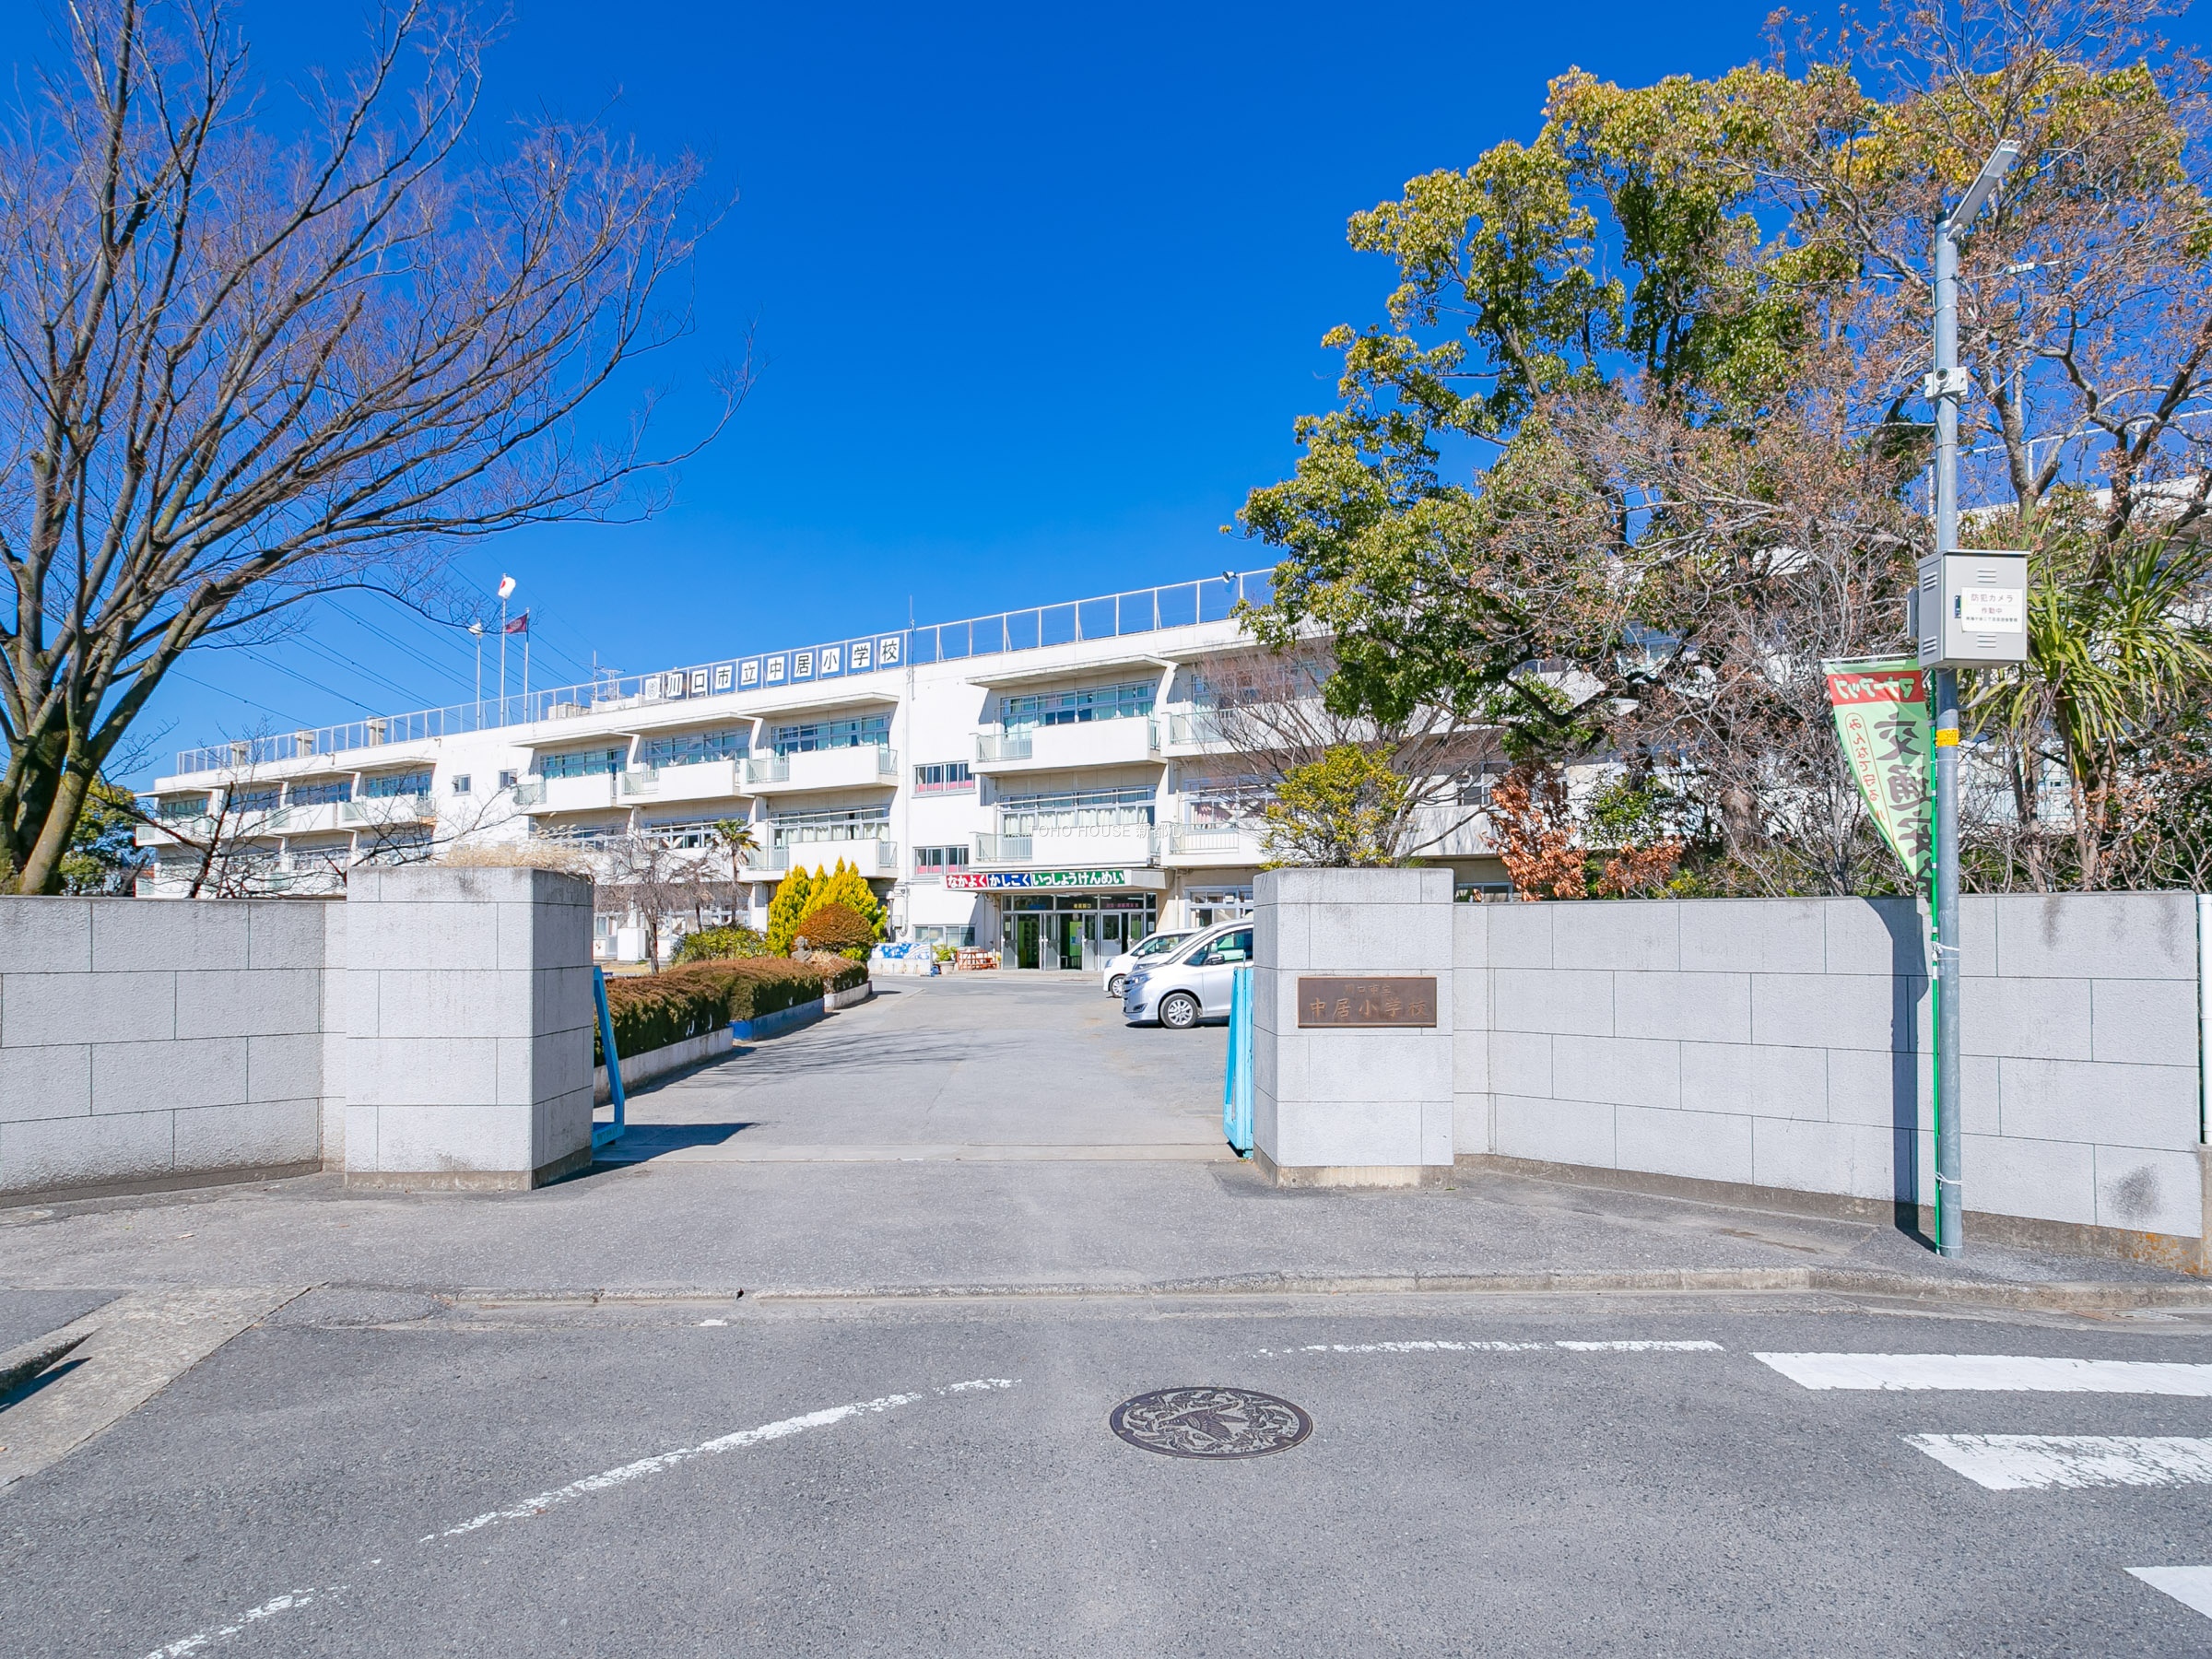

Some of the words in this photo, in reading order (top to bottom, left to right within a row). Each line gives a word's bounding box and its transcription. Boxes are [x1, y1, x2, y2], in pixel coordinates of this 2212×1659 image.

[1971, 594, 2014, 604] 防犯カメラ
[667, 640, 898, 695] 川口市立中居小学校
[947, 874, 987, 888] なかよく
[989, 873, 1029, 888] かしこく
[1032, 870, 1125, 887] いっしょうけんめい
[1310, 997, 1429, 1018] 中居小学校
